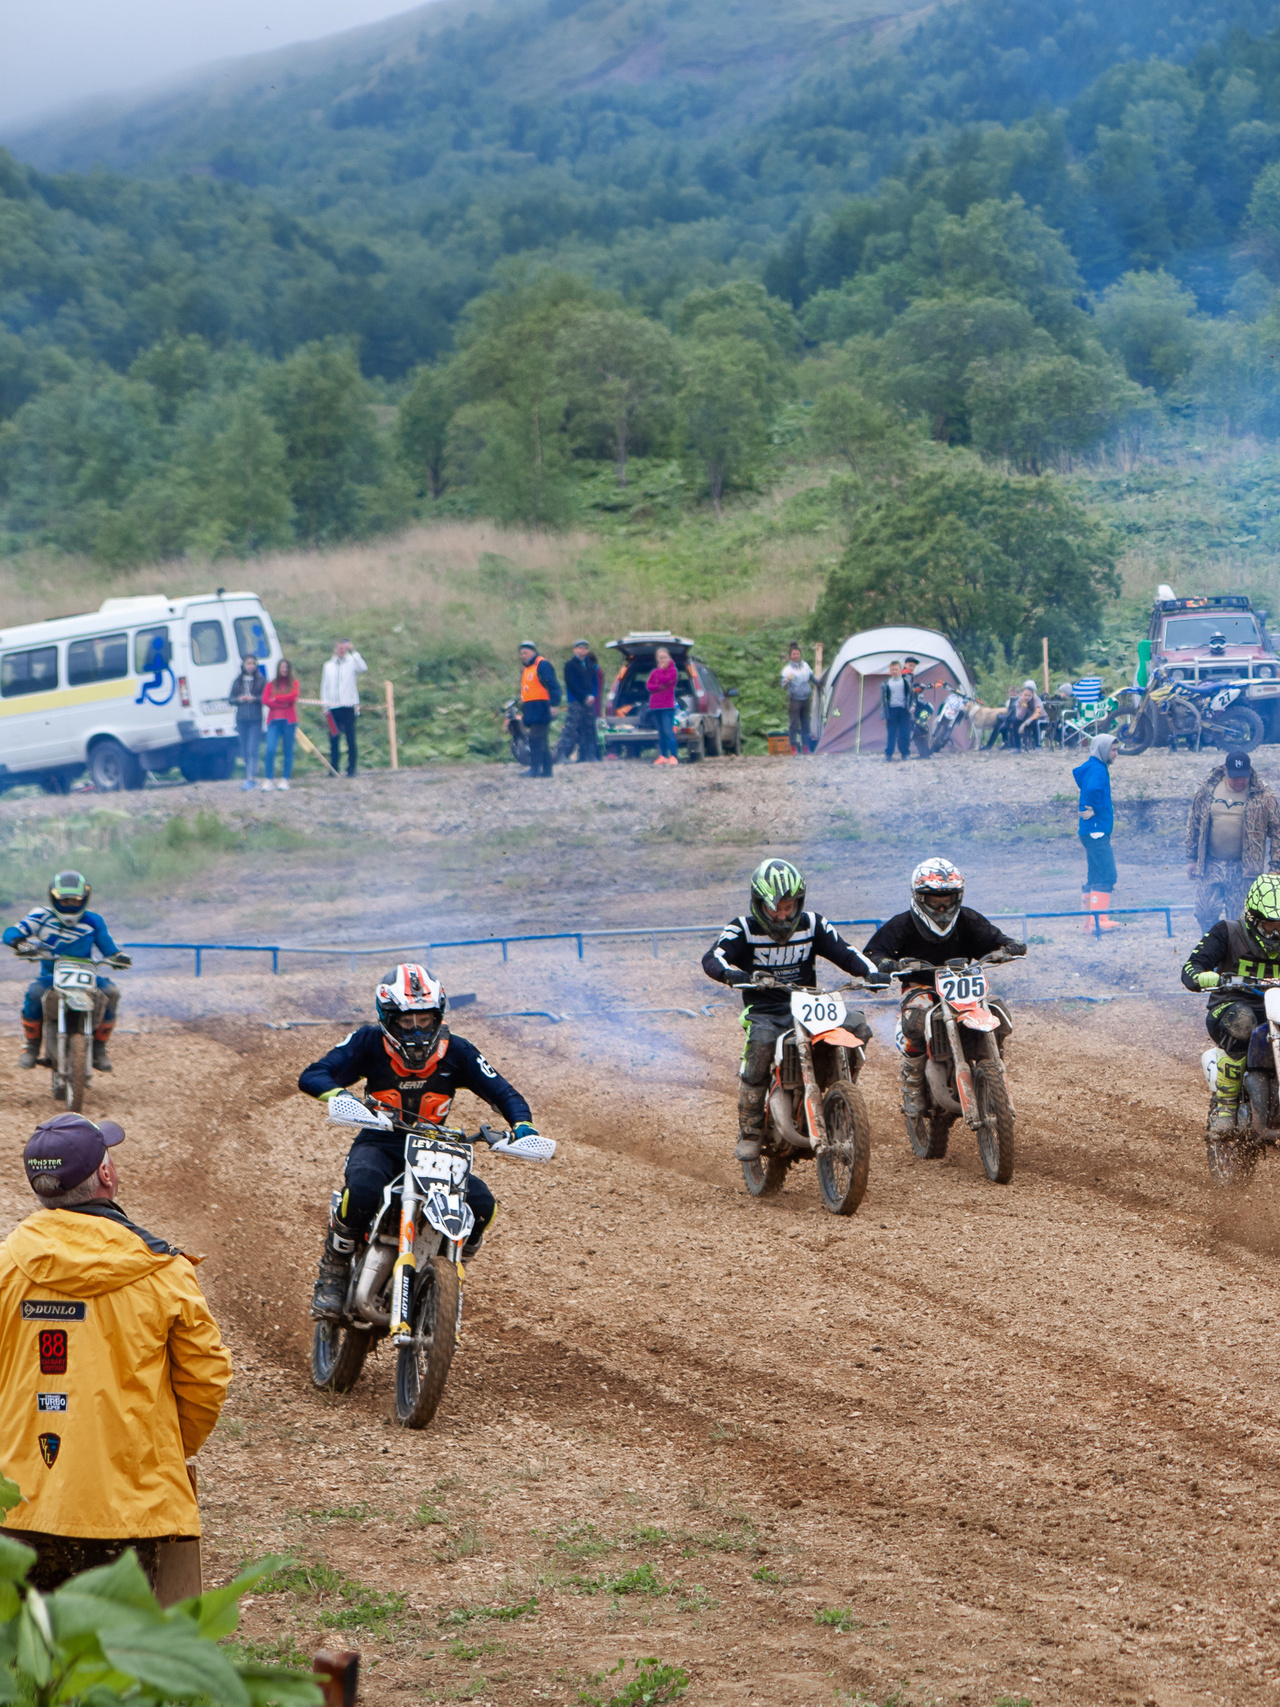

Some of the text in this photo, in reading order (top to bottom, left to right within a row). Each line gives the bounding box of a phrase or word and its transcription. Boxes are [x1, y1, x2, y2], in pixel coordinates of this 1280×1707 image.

[1219, 691, 1231, 706] 27
[752, 941, 814, 966] SHIFT
[60, 971, 93, 985] 70
[942, 976, 985, 1001] 205
[801, 1002, 838, 1023] 208
[399, 1080, 427, 1090] LEATT
[411, 1139, 434, 1149] LEV
[27, 1158, 62, 1166] MONSTER
[412, 1149, 469, 1185] 333
[401, 1275, 410, 1320] DUNLOP
[35, 1305, 77, 1315] DUNLO
[42, 1332, 65, 1358] 88
[40, 1397, 66, 1407] TURBO
